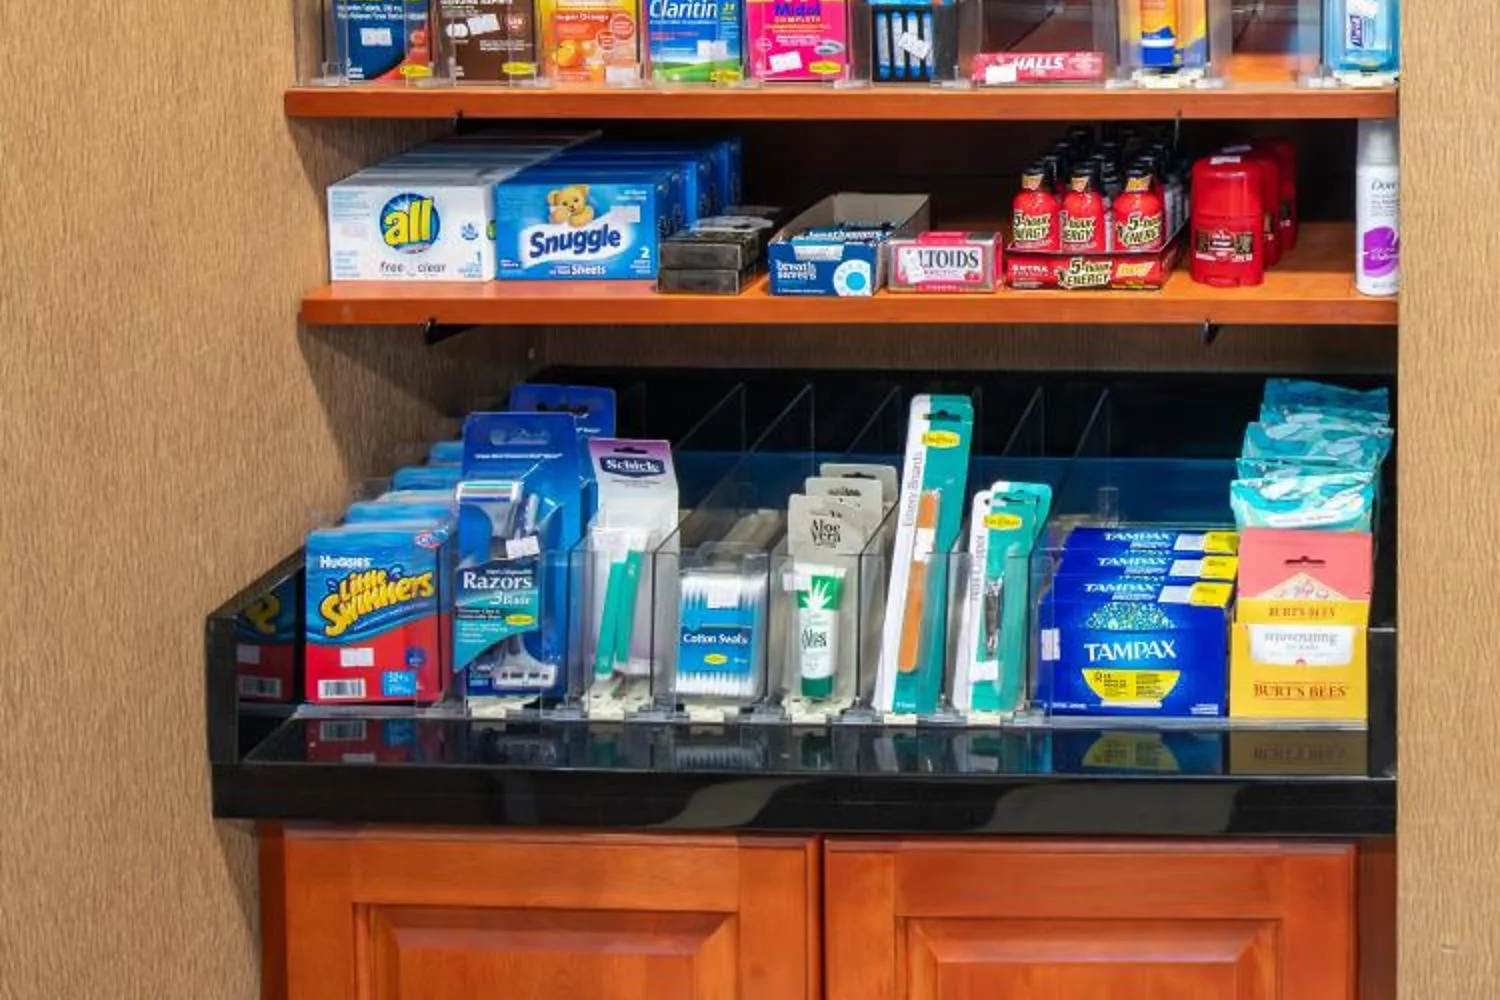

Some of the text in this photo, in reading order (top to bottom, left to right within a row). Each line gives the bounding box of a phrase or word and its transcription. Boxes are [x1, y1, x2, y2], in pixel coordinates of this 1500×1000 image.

[773, 3, 822, 17] Midol
[1011, 56, 1065, 71] HALLS
[384, 197, 435, 246] all
[529, 222, 621, 259] Snuggle
[640, 247, 650, 258] 2
[379, 261, 447, 273] free clear
[1066, 271, 1110, 287] ENERGY
[603, 458, 660, 473] Schick
[810, 518, 842, 534] Aloe
[1104, 531, 1171, 542] TAMPAX
[319, 555, 372, 569] HUGGIES
[1097, 557, 1169, 568] TAMPAX
[462, 570, 533, 591] Razors
[1084, 583, 1157, 594] TAMPAX
[682, 633, 718, 644] Cotton
[1083, 639, 1178, 663] TAMPAX
[1253, 682, 1348, 699] BURT'S BEES
